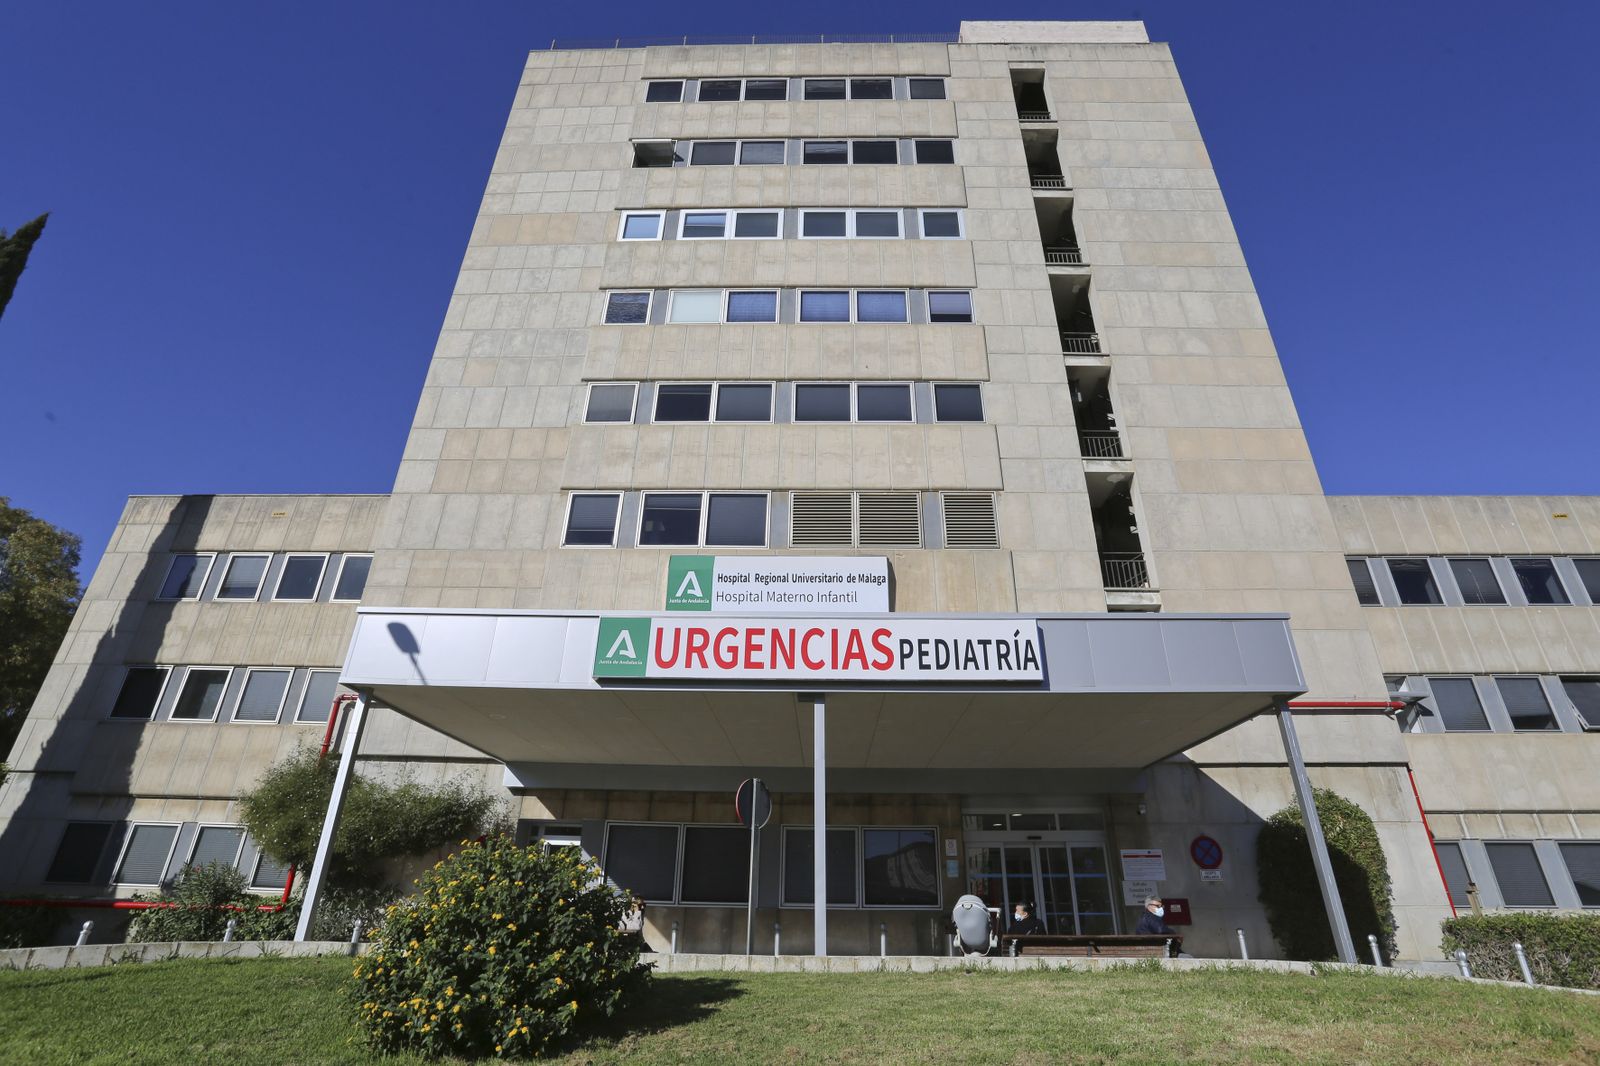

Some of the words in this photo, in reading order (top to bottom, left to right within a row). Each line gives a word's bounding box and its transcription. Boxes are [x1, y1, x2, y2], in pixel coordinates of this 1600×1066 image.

[717, 572, 751, 585] Hospital
[754, 572, 789, 586] Regional
[791, 572, 844, 584] Universitario
[846, 573, 857, 584] de
[716, 590, 763, 605] Hospital
[766, 591, 814, 603] Materno
[817, 590, 858, 603] Infantil
[654, 626, 895, 672] URGENCIAS
[899, 629, 1040, 671] PEDIATRÍA
